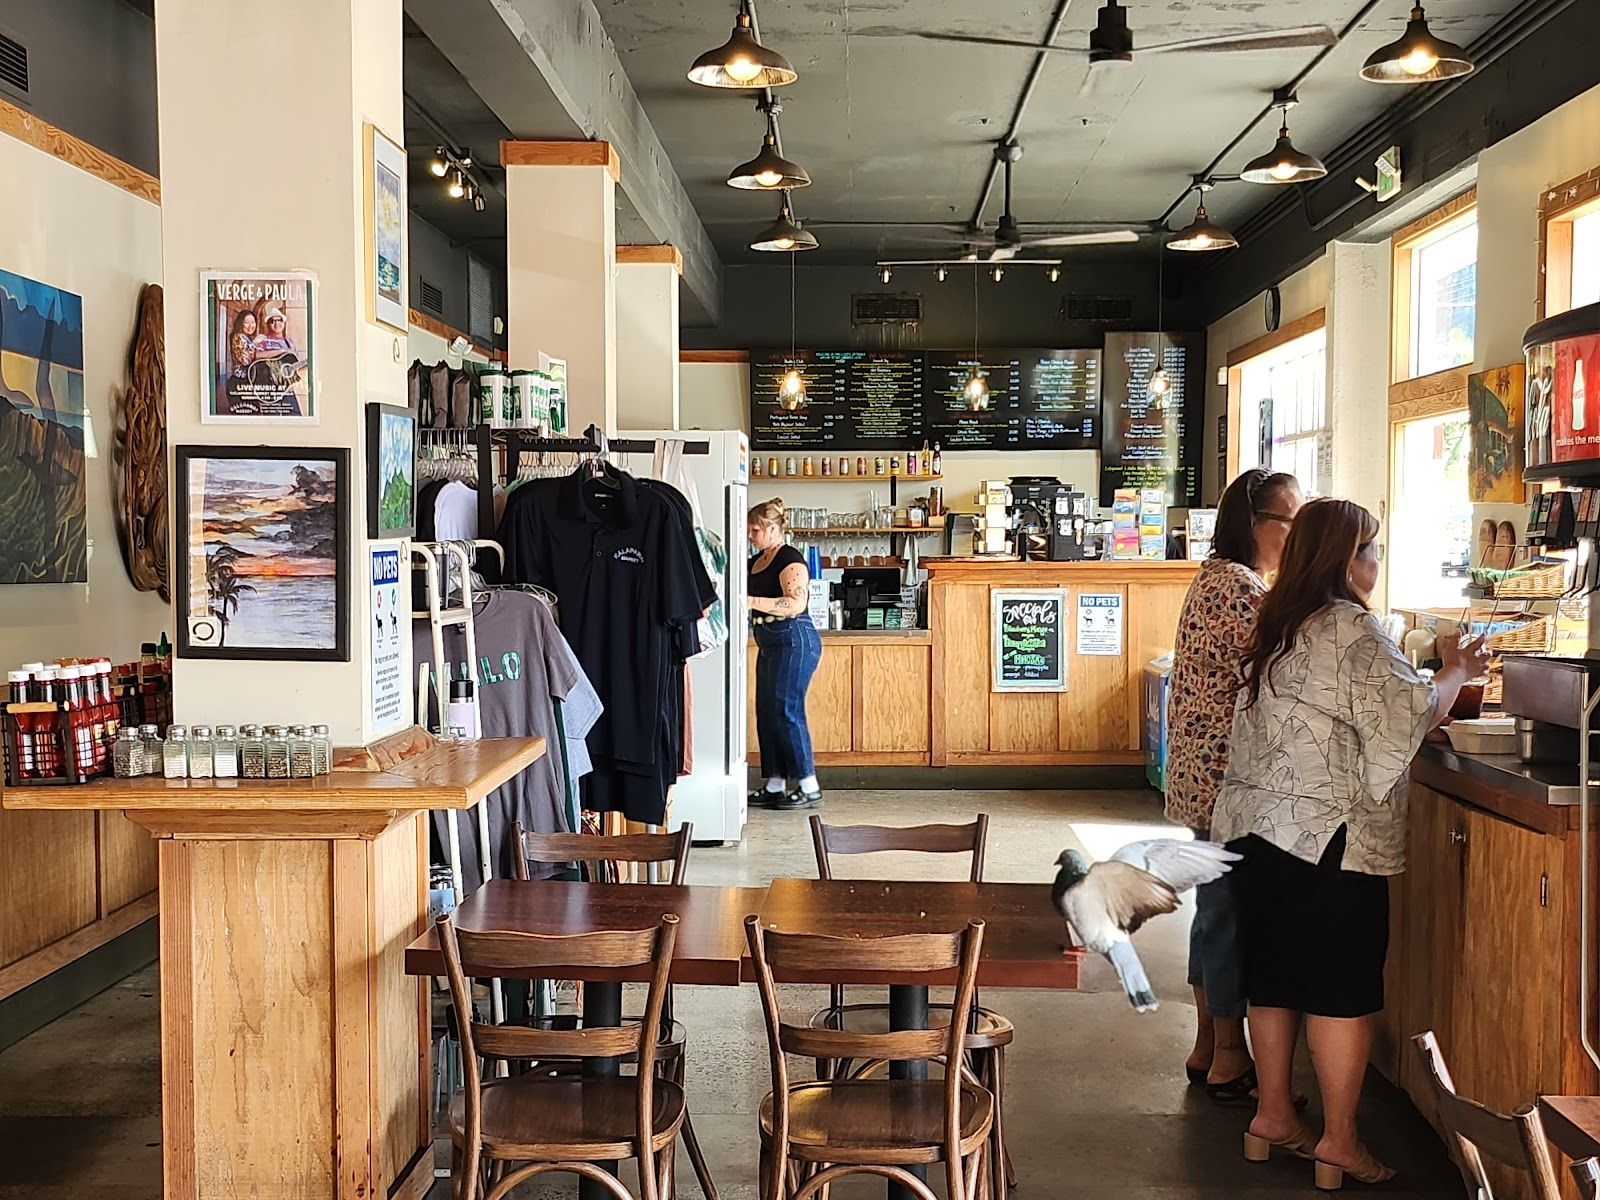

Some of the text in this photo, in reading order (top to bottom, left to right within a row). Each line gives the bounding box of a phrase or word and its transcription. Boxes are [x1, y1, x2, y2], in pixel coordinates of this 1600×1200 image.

[217, 283, 303, 300] VERGE & PAULA
[1574, 435, 1586, 445] the
[373, 555, 398, 580] NO PETS
[1082, 597, 1118, 606] NO PETS
